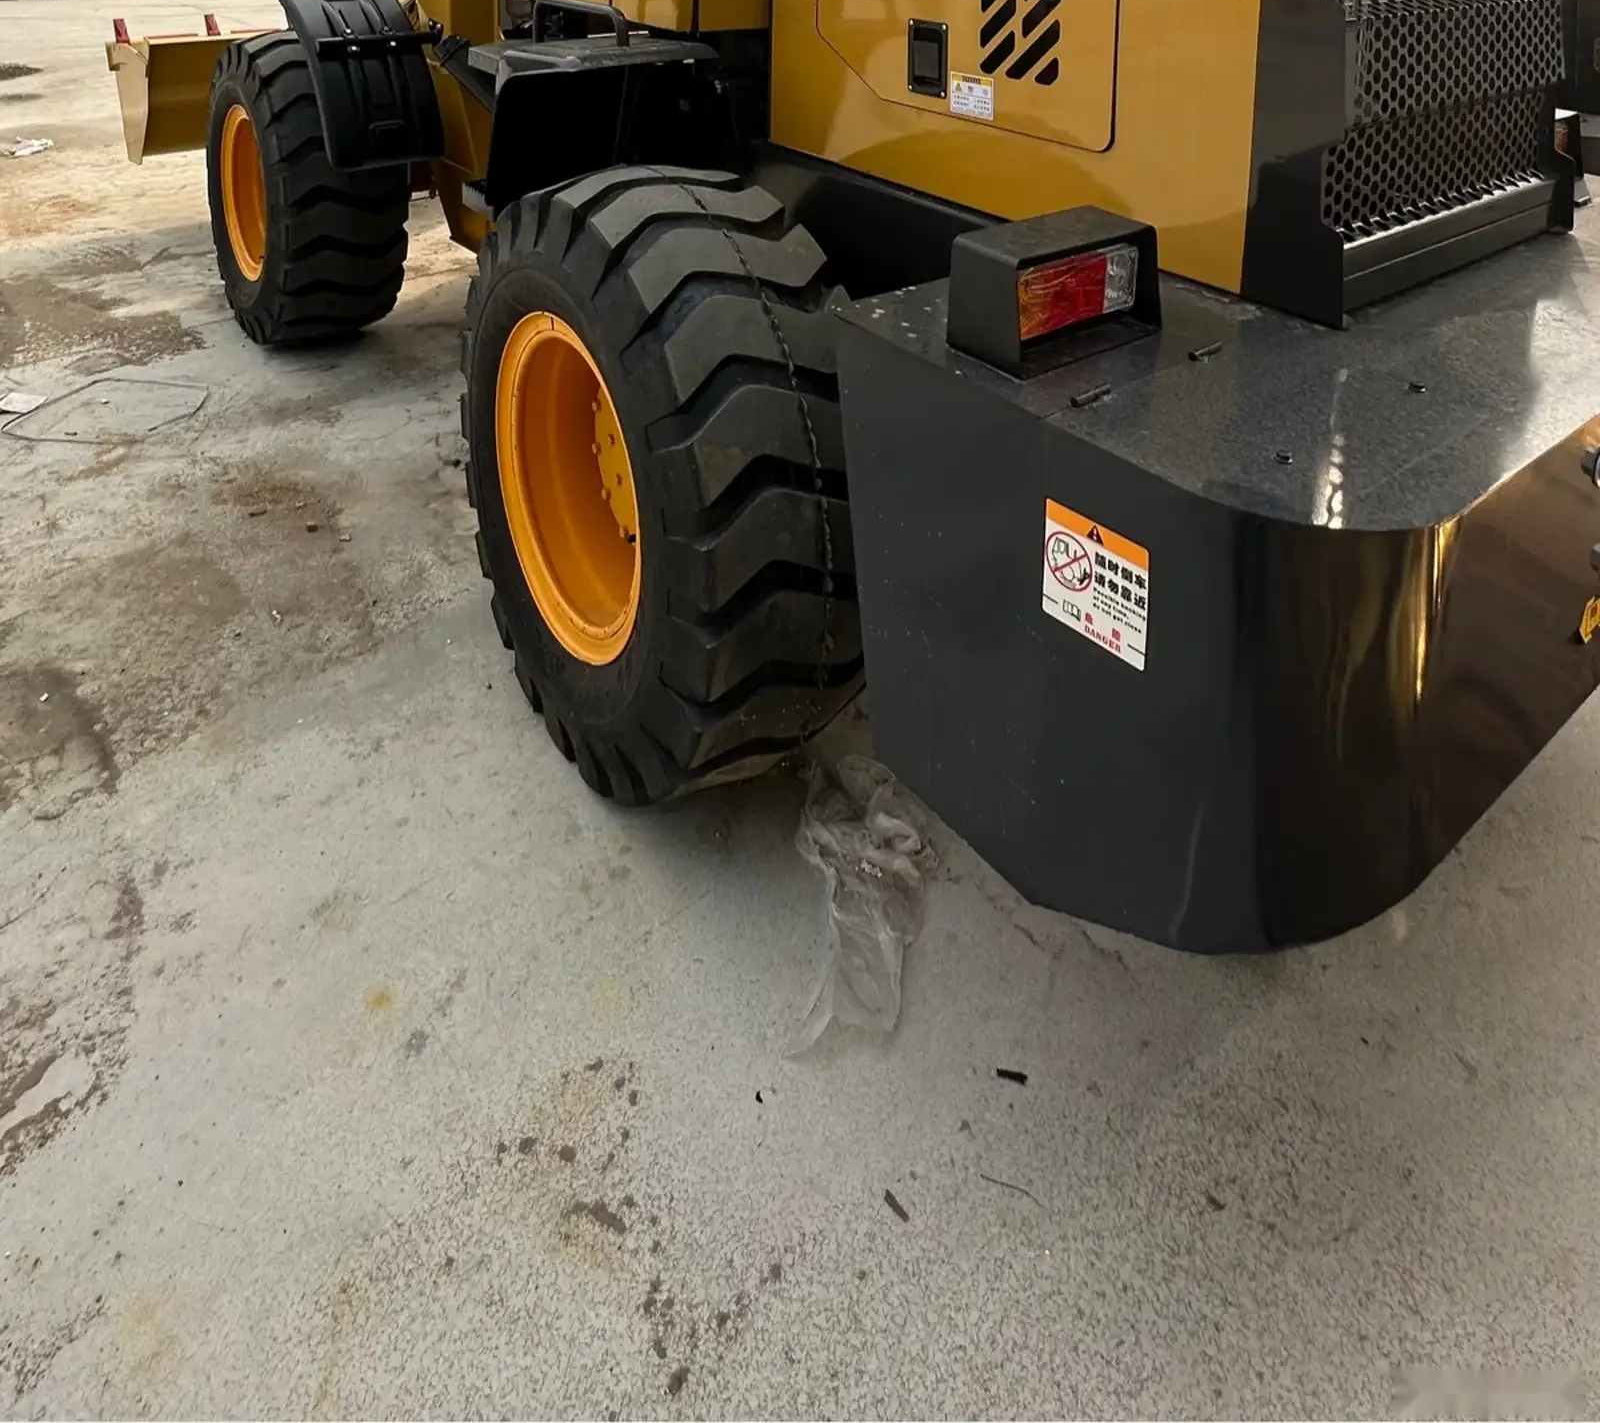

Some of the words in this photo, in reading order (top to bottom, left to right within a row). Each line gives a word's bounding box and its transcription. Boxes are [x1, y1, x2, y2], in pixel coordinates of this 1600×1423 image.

[1095, 551, 1147, 590] 随时倒车
[1094, 571, 1146, 611] 请勿靠近
[1084, 624, 1121, 654] DANGER
